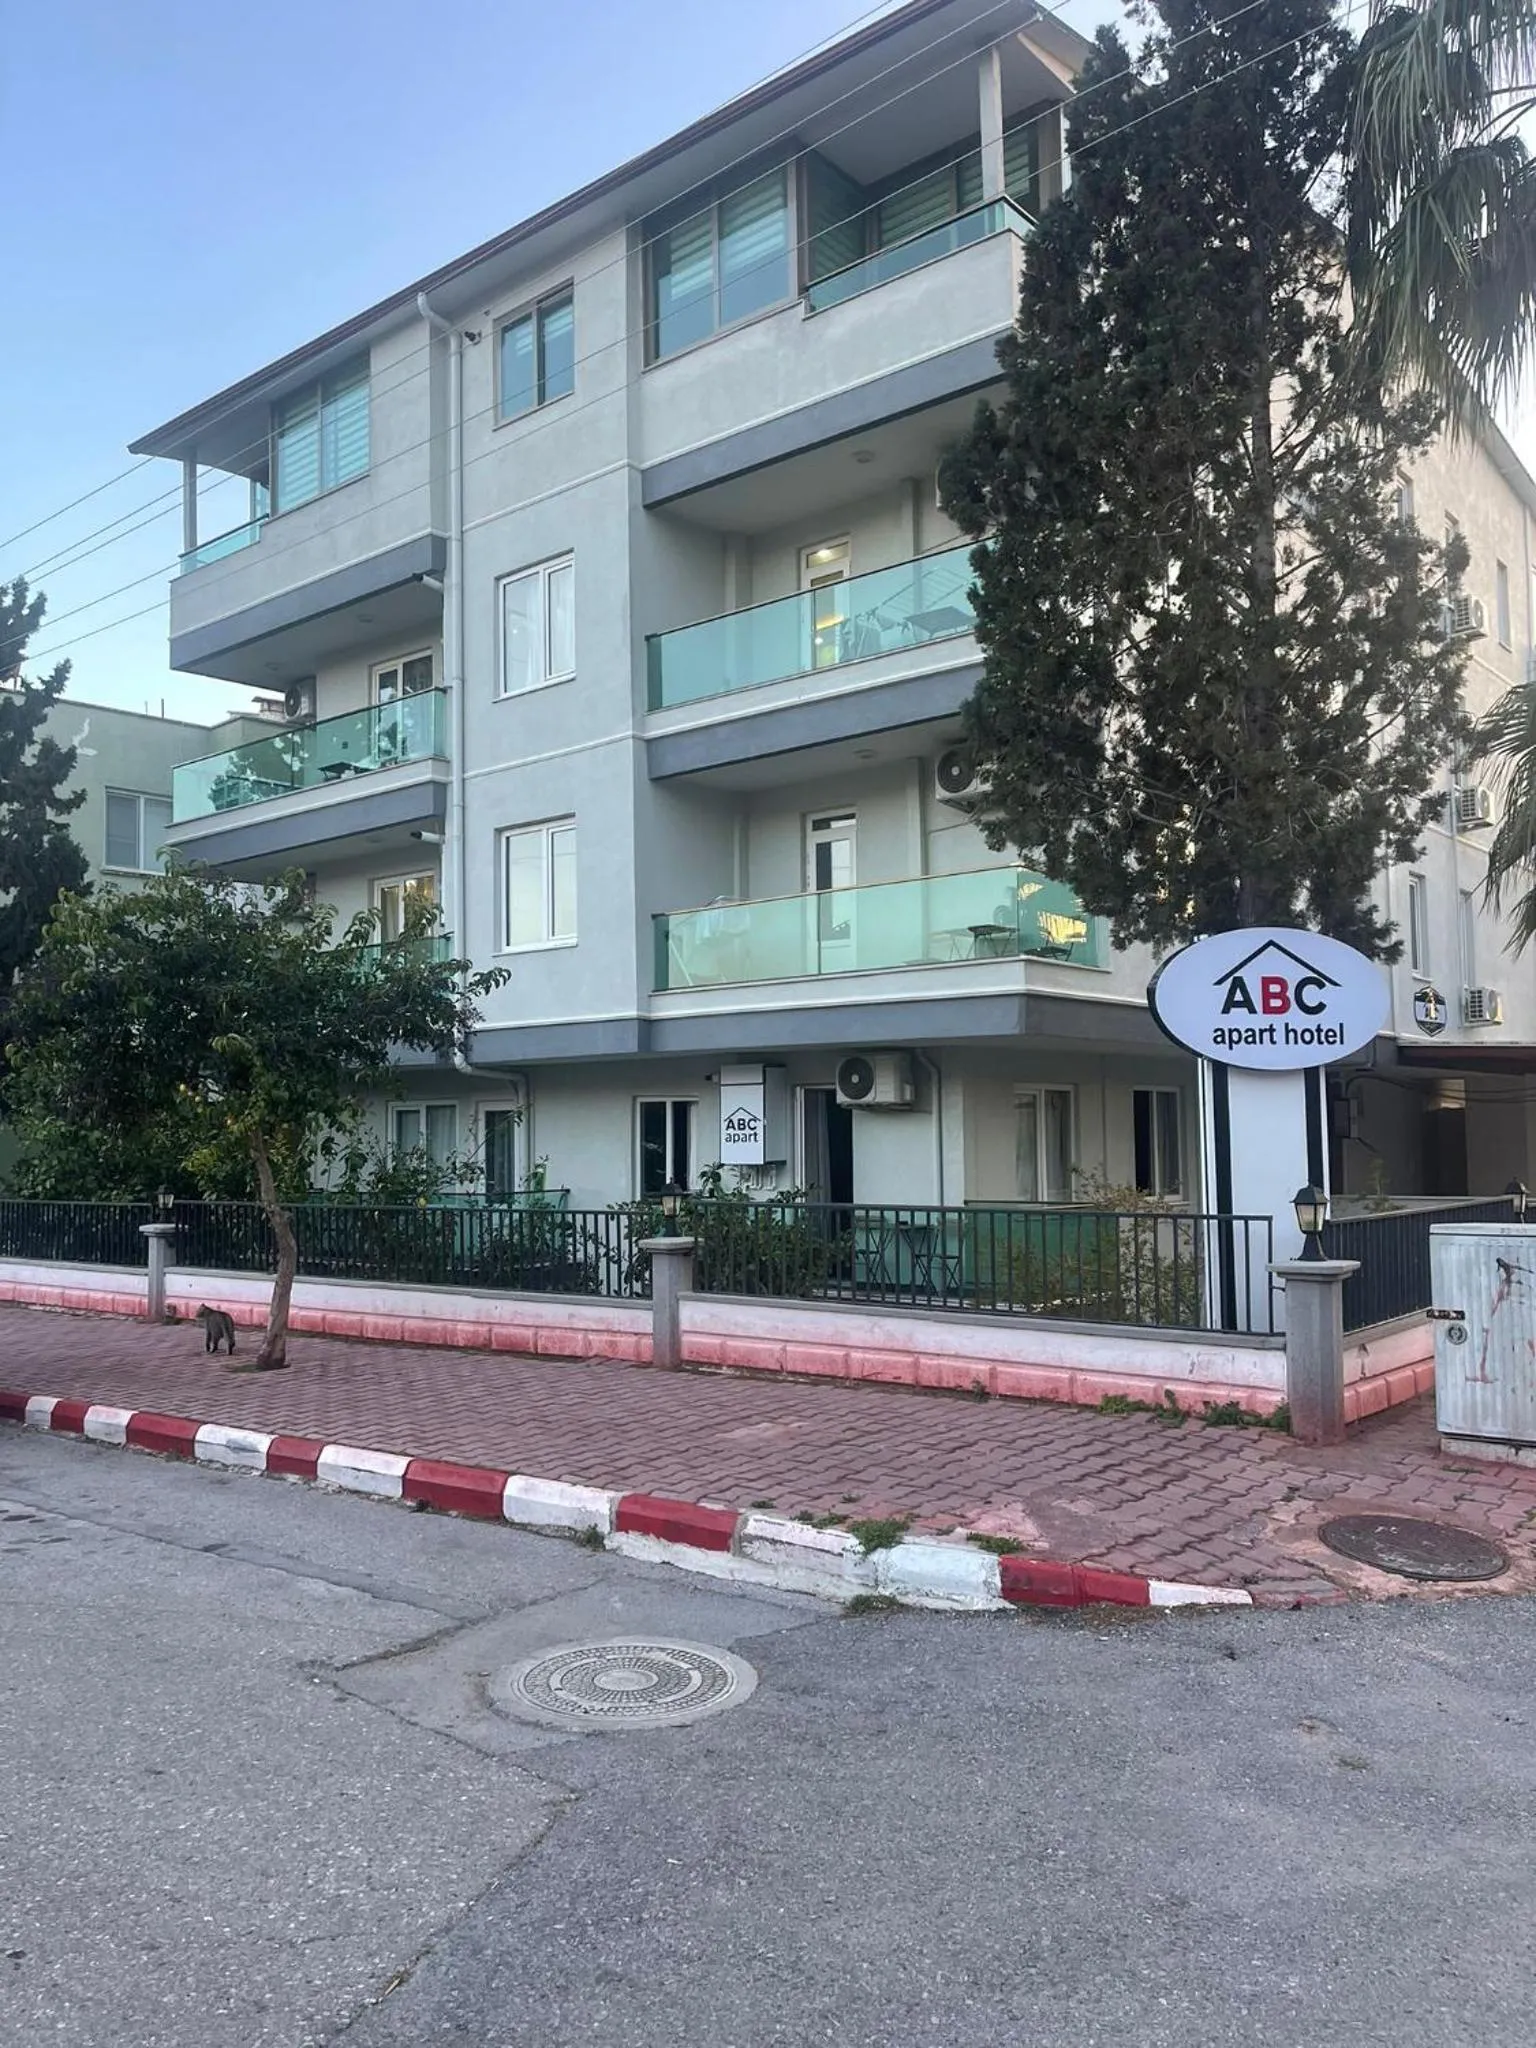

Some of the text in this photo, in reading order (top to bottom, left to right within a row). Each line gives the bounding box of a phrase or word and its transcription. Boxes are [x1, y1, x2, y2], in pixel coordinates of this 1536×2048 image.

[1220, 975, 1328, 1016] ABC
[1212, 1022, 1345, 1052] apart hotel
[725, 1118, 758, 1131] ABC
[724, 1131, 759, 1144] apart
